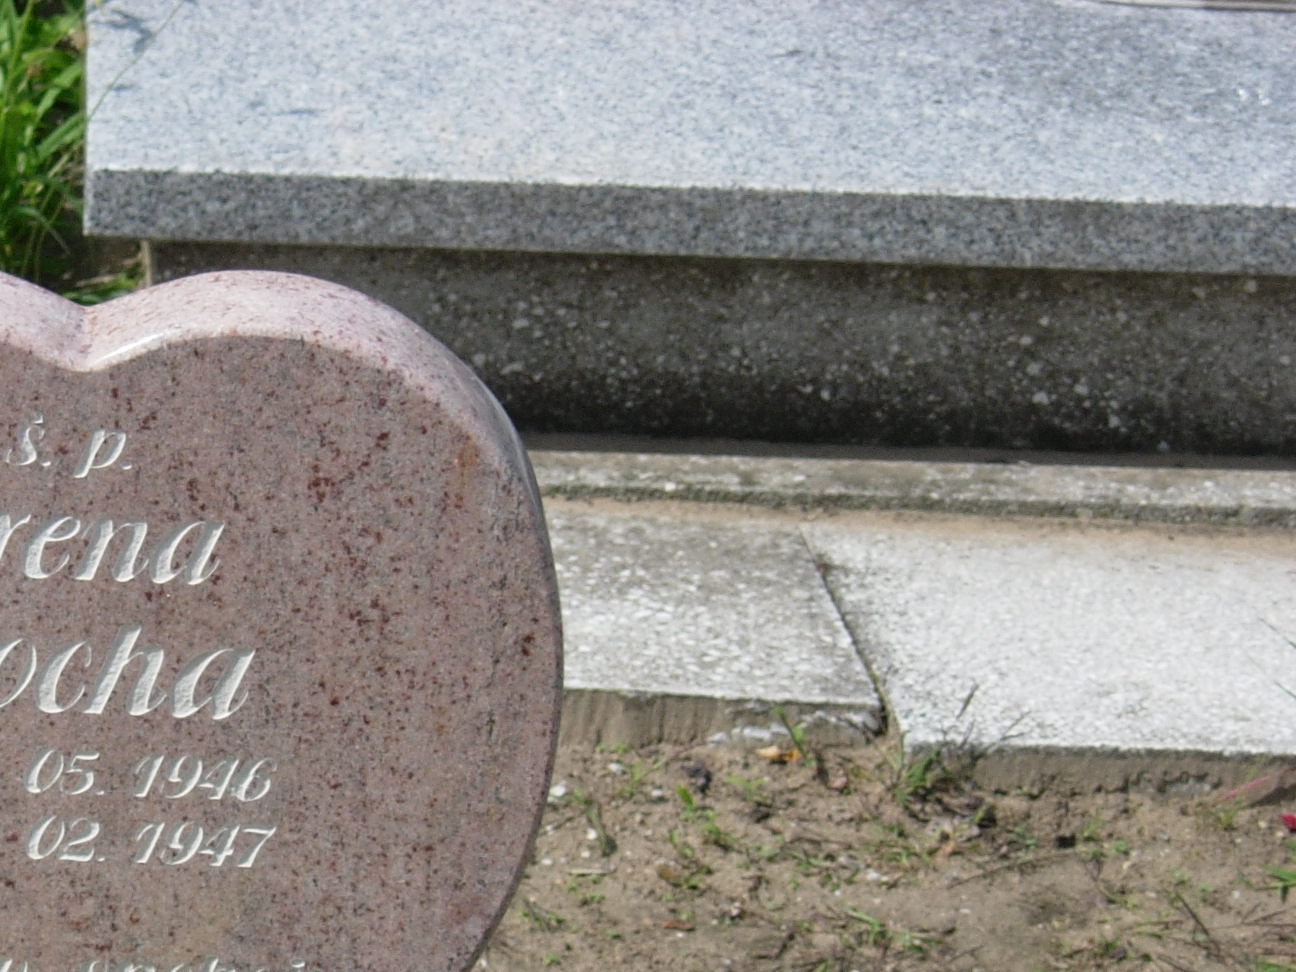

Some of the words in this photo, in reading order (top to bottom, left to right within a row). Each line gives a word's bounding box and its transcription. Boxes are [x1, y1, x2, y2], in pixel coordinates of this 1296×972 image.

[72, 427, 133, 479] p.
[24, 747, 105, 796] 05.
[133, 753, 278, 803] 1946
[26, 813, 105, 863] 02.
[133, 820, 278, 869] 1947
